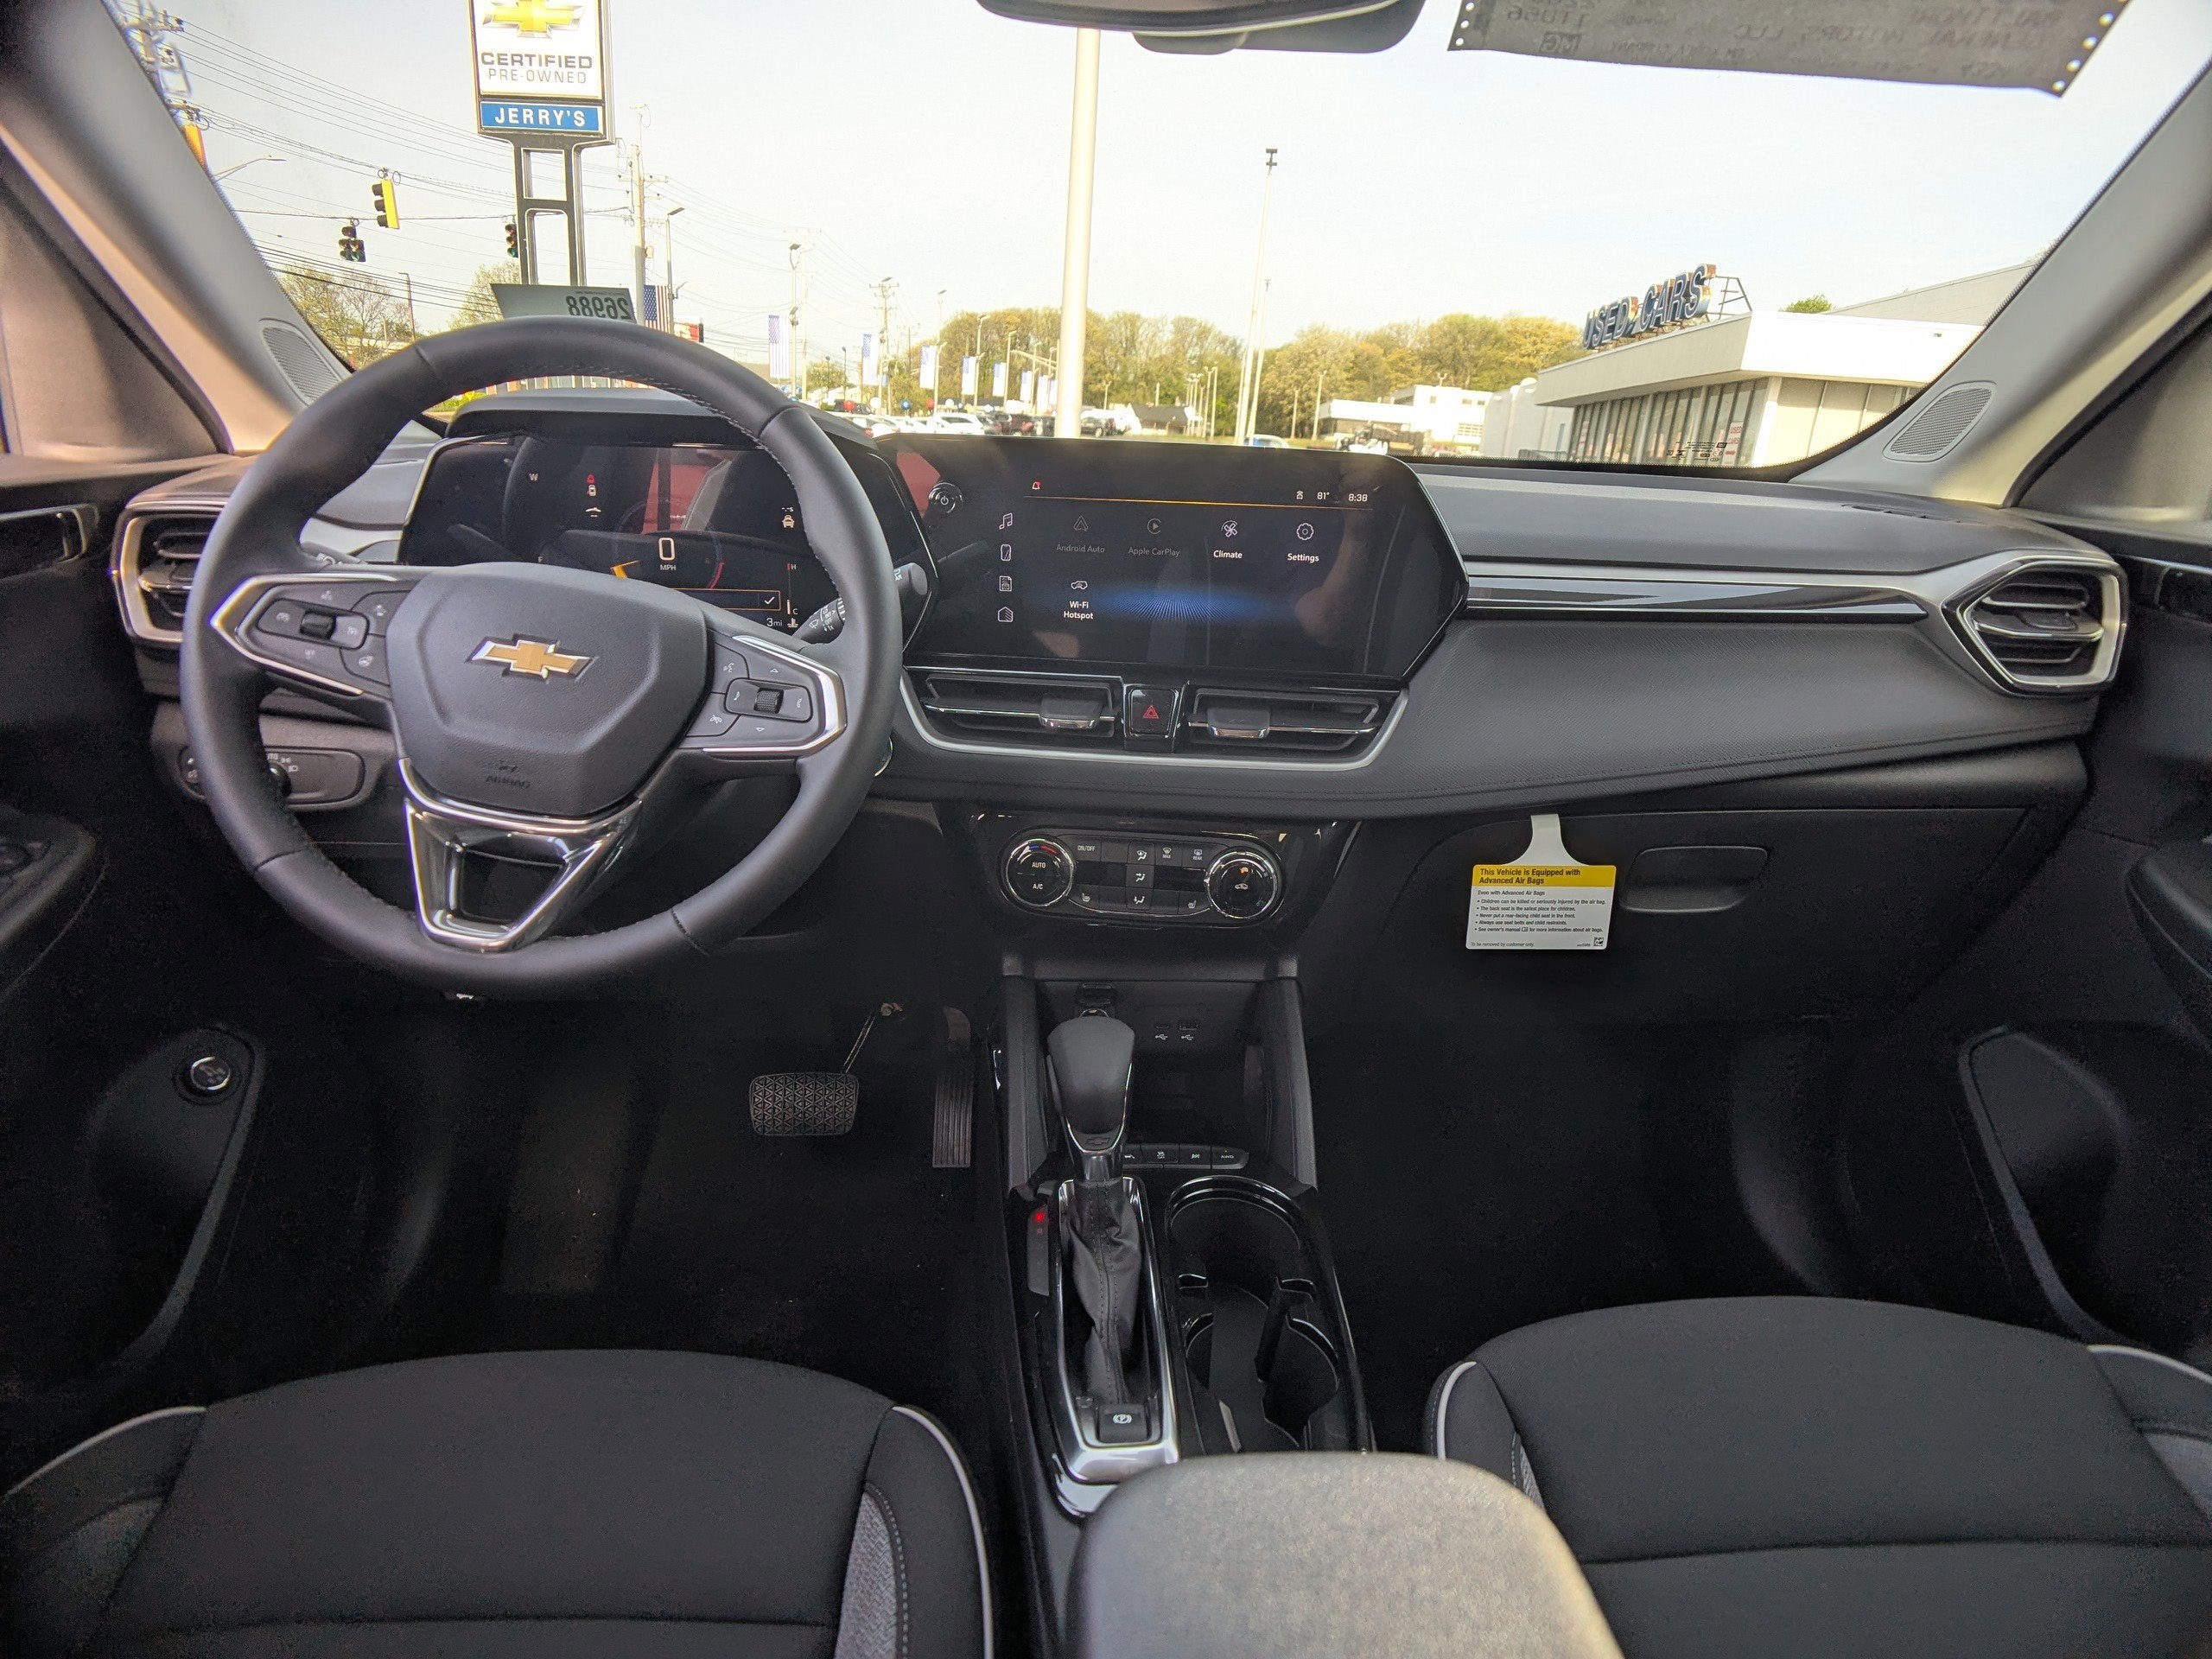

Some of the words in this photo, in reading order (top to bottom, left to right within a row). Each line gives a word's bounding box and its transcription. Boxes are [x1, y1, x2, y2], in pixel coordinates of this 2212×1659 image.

[480, 52, 593, 69] CERTIFIED
[488, 68, 587, 84] PRE-OWNED
[494, 107, 586, 127] JERRY'S
[1583, 296, 1635, 350] USED
[1639, 263, 1713, 333] CARS
[1316, 491, 1331, 500] 81°
[1348, 493, 1368, 503] 8:38
[658, 537, 676, 561] 0
[1056, 543, 1086, 553] Android
[1087, 545, 1105, 554] Auto
[1128, 547, 1151, 557] Apple
[1152, 548, 1181, 558] CarPlay
[1213, 550, 1243, 560] Climate
[1287, 552, 1319, 564] Settings
[1069, 601, 1089, 610] Wi-Fi
[1063, 610, 1094, 620] Hotspot
[1077, 844, 1096, 853] ON/OFF
[1527, 877, 1545, 886] Bags
